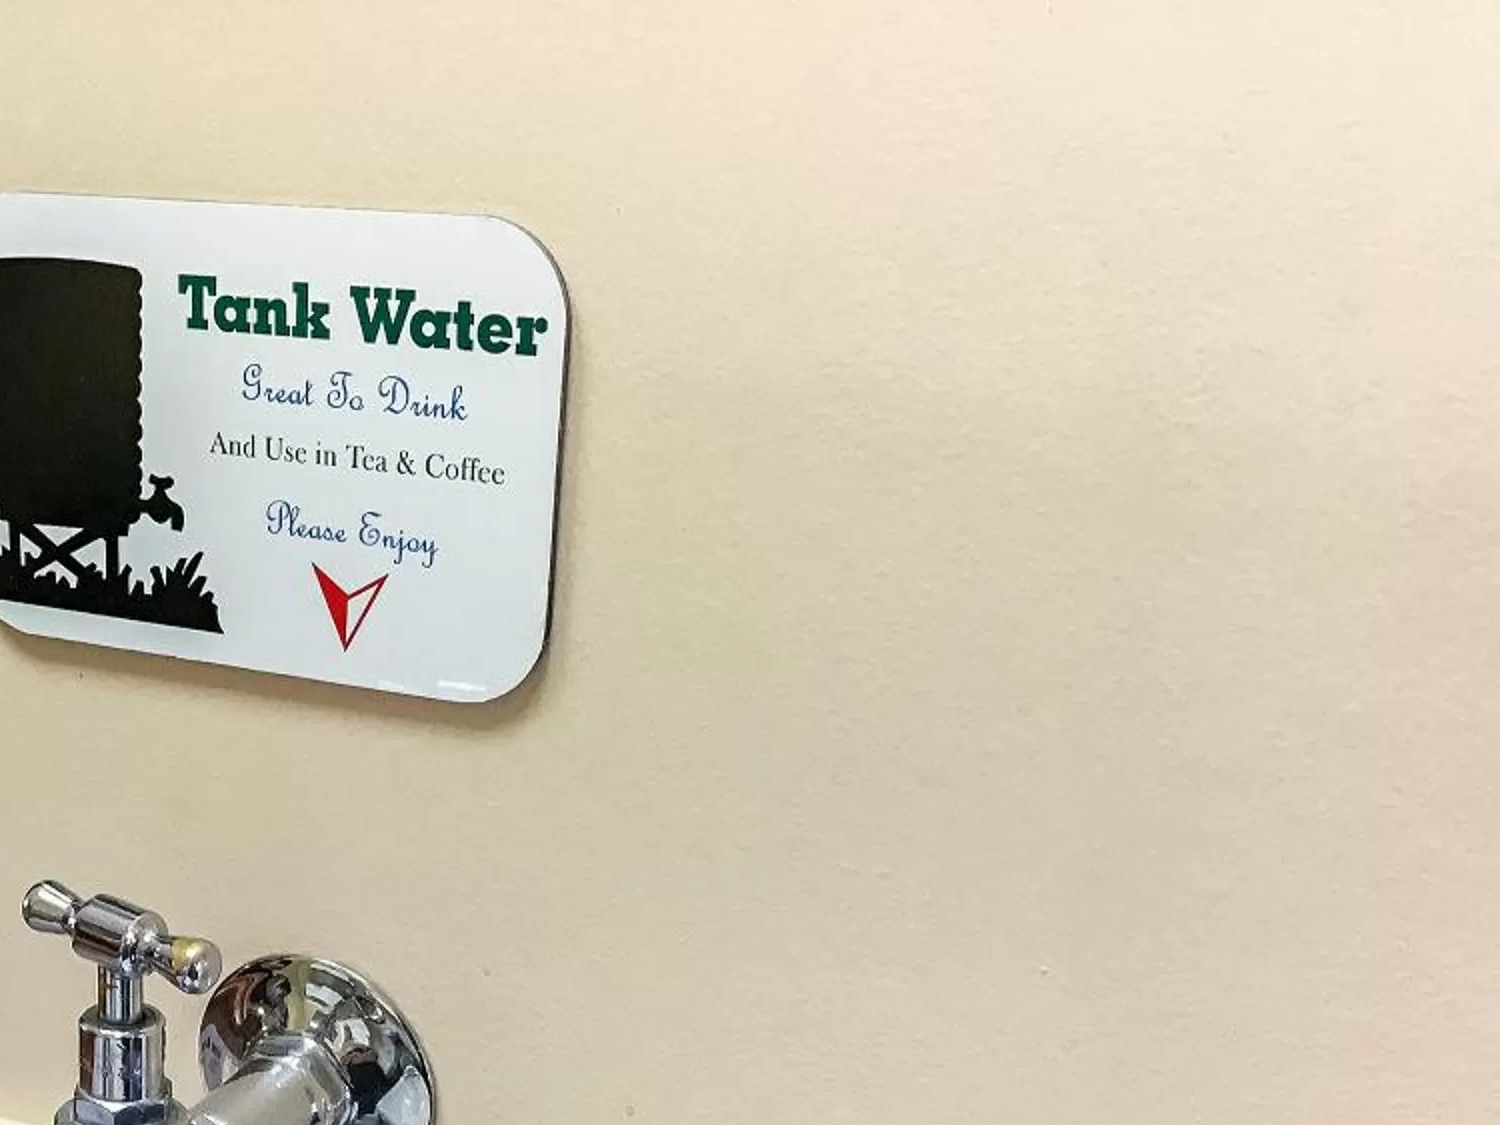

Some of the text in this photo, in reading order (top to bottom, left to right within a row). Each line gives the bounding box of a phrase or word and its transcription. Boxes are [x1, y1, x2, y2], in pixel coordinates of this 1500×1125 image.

[178, 274, 548, 356] Tank Water
[242, 364, 467, 421] Great To Drink
[210, 432, 505, 485] And Use in Tea & Coffee
[266, 500, 438, 568] Please Enjoy
